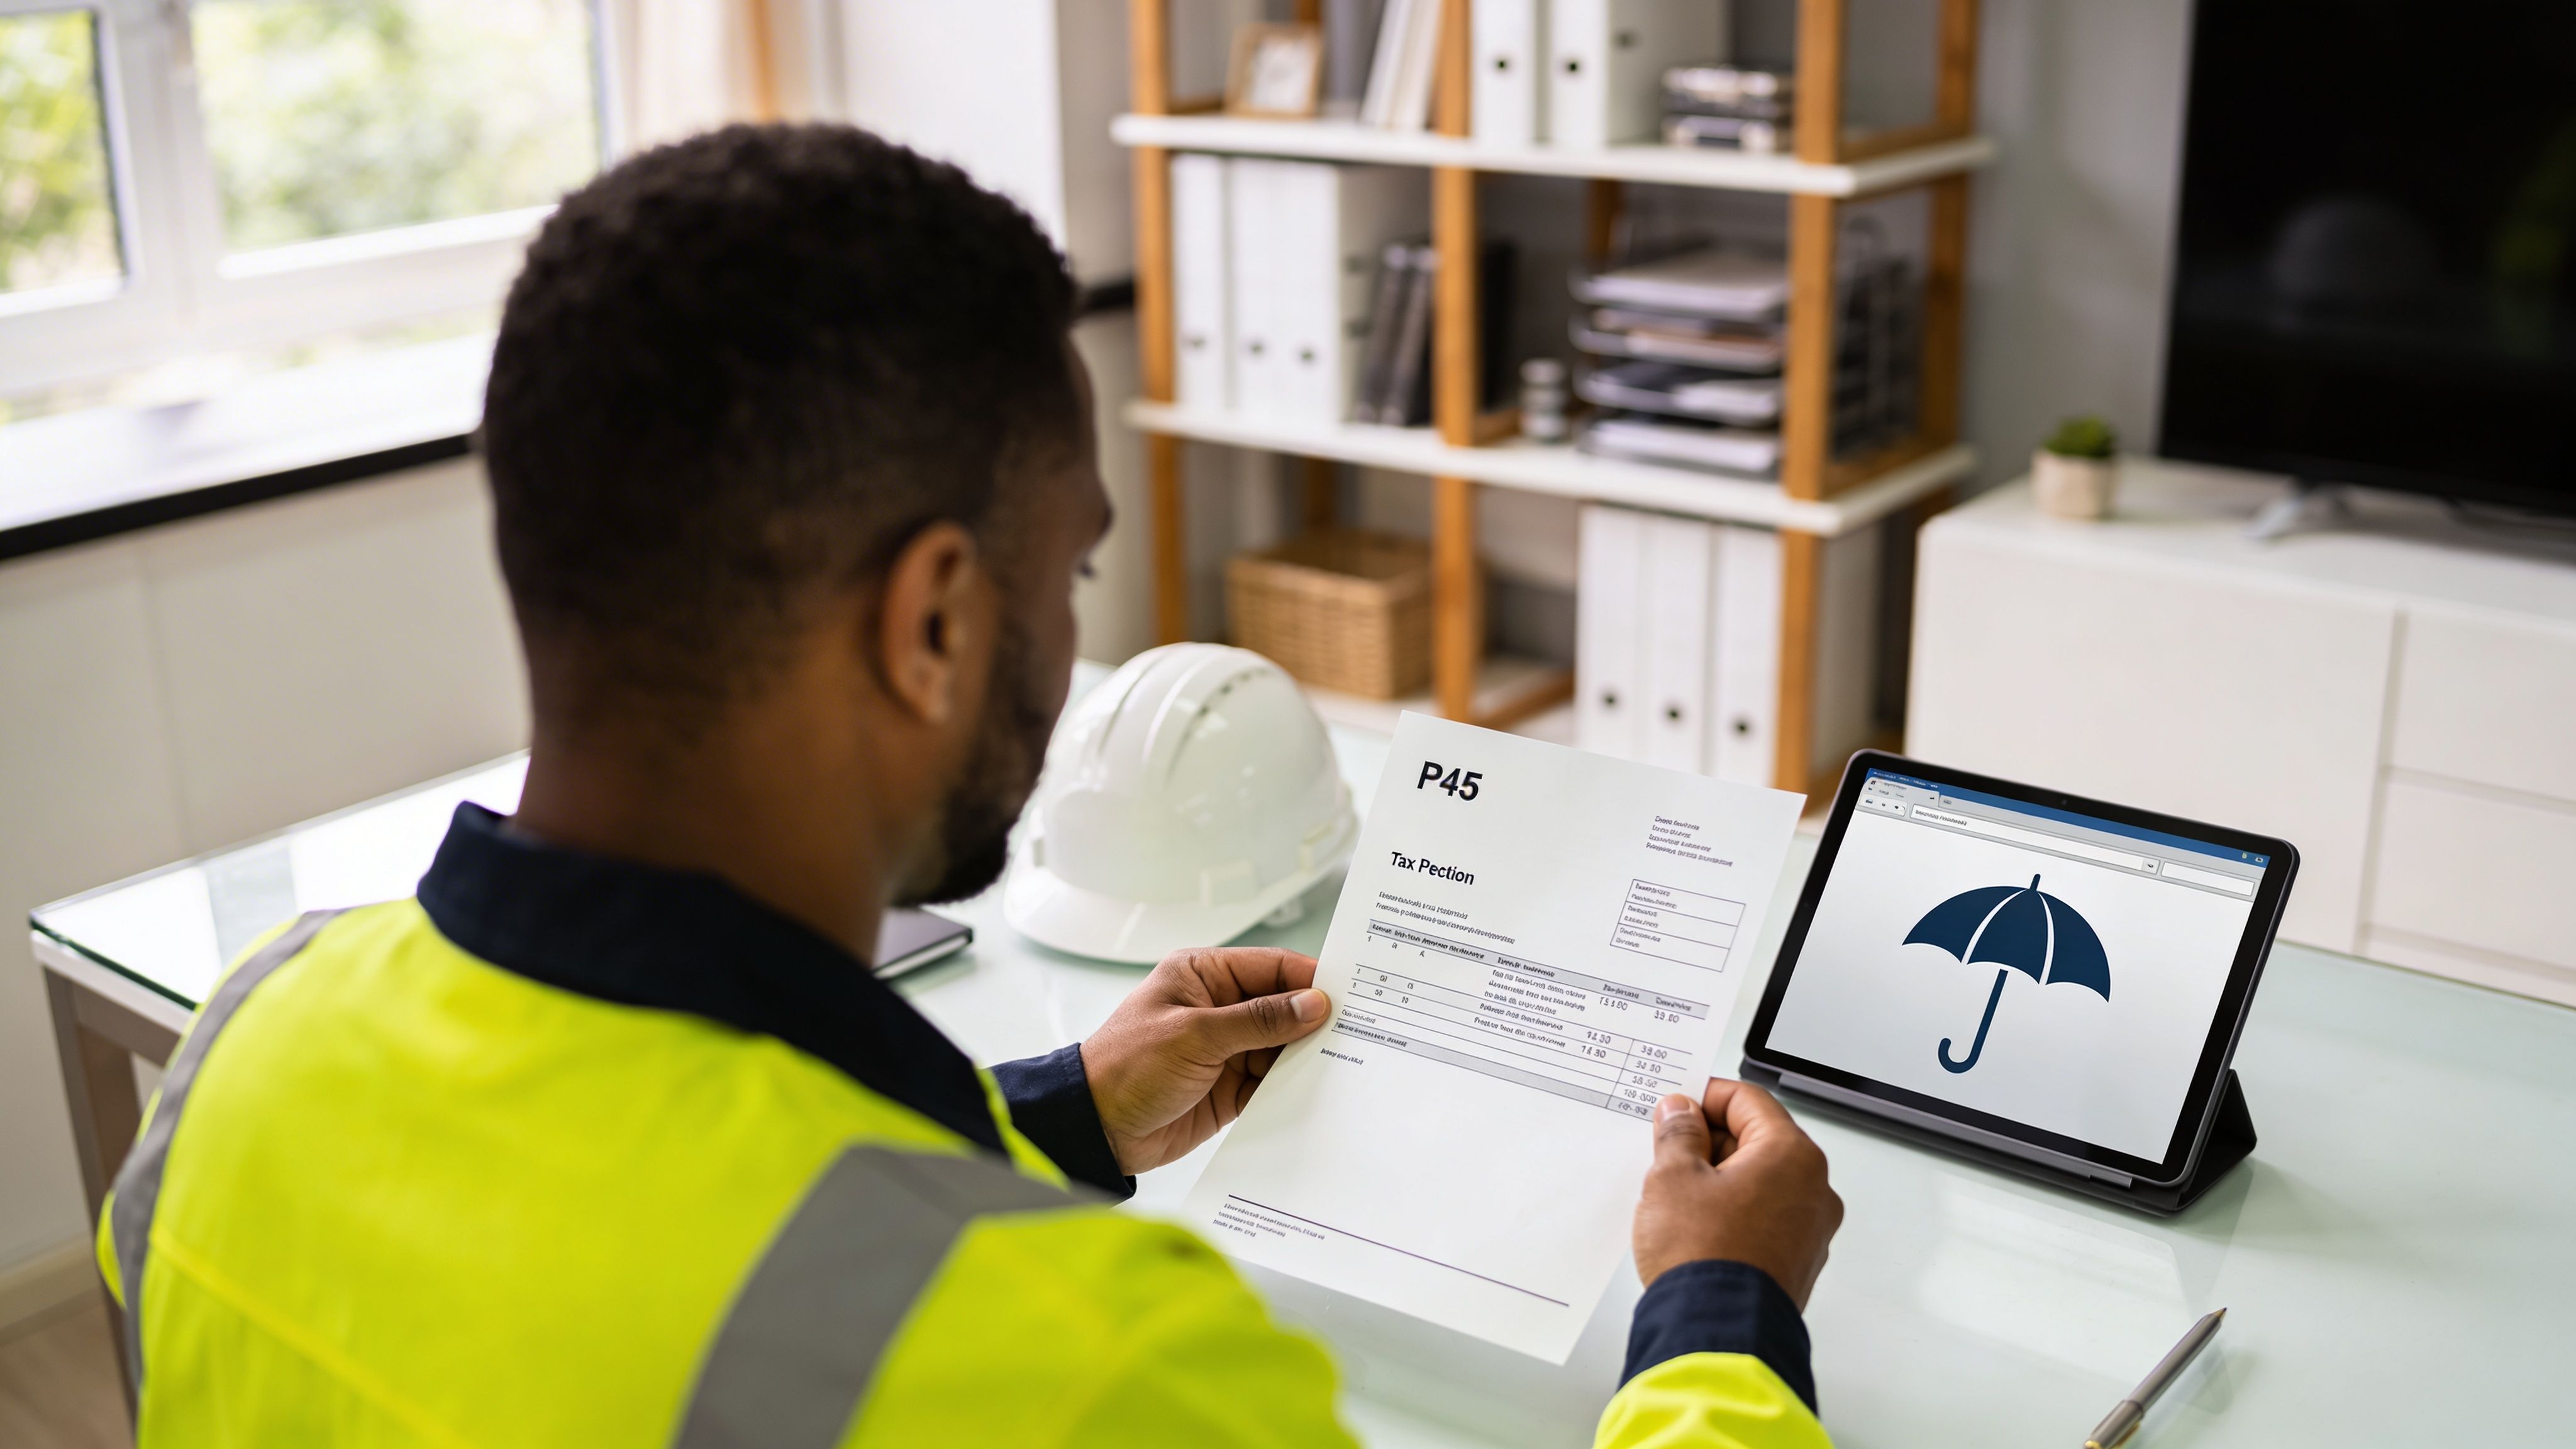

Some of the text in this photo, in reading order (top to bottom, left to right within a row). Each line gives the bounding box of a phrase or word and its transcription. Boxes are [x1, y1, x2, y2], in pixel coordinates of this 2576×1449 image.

[1417, 761, 1483, 801] P45
[1392, 852, 1475, 885] Tax Pection
